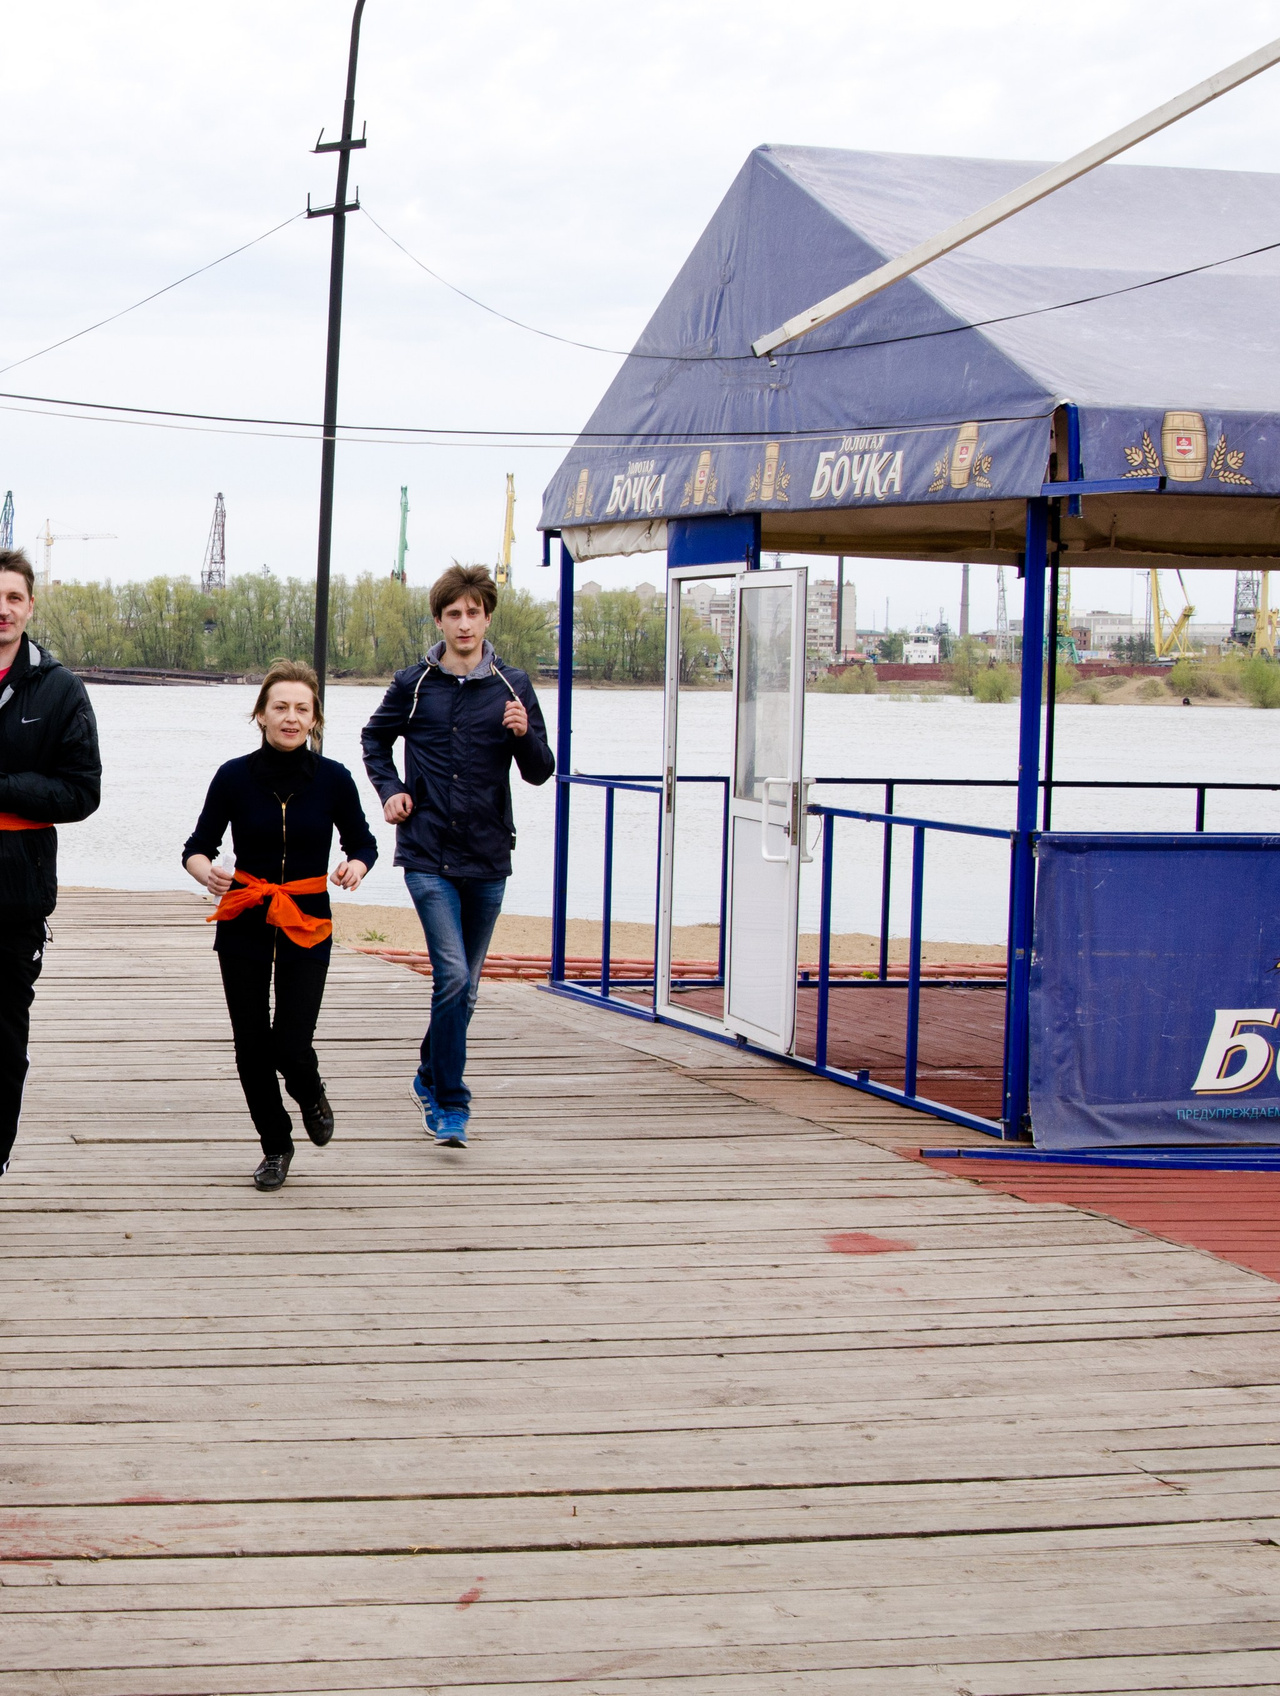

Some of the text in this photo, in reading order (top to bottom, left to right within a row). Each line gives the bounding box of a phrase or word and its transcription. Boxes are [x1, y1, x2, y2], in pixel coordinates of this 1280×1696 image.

[605, 473, 667, 516] БОЧКА
[809, 450, 904, 501] БОЧКА
[1190, 1008, 1280, 1095] Б
